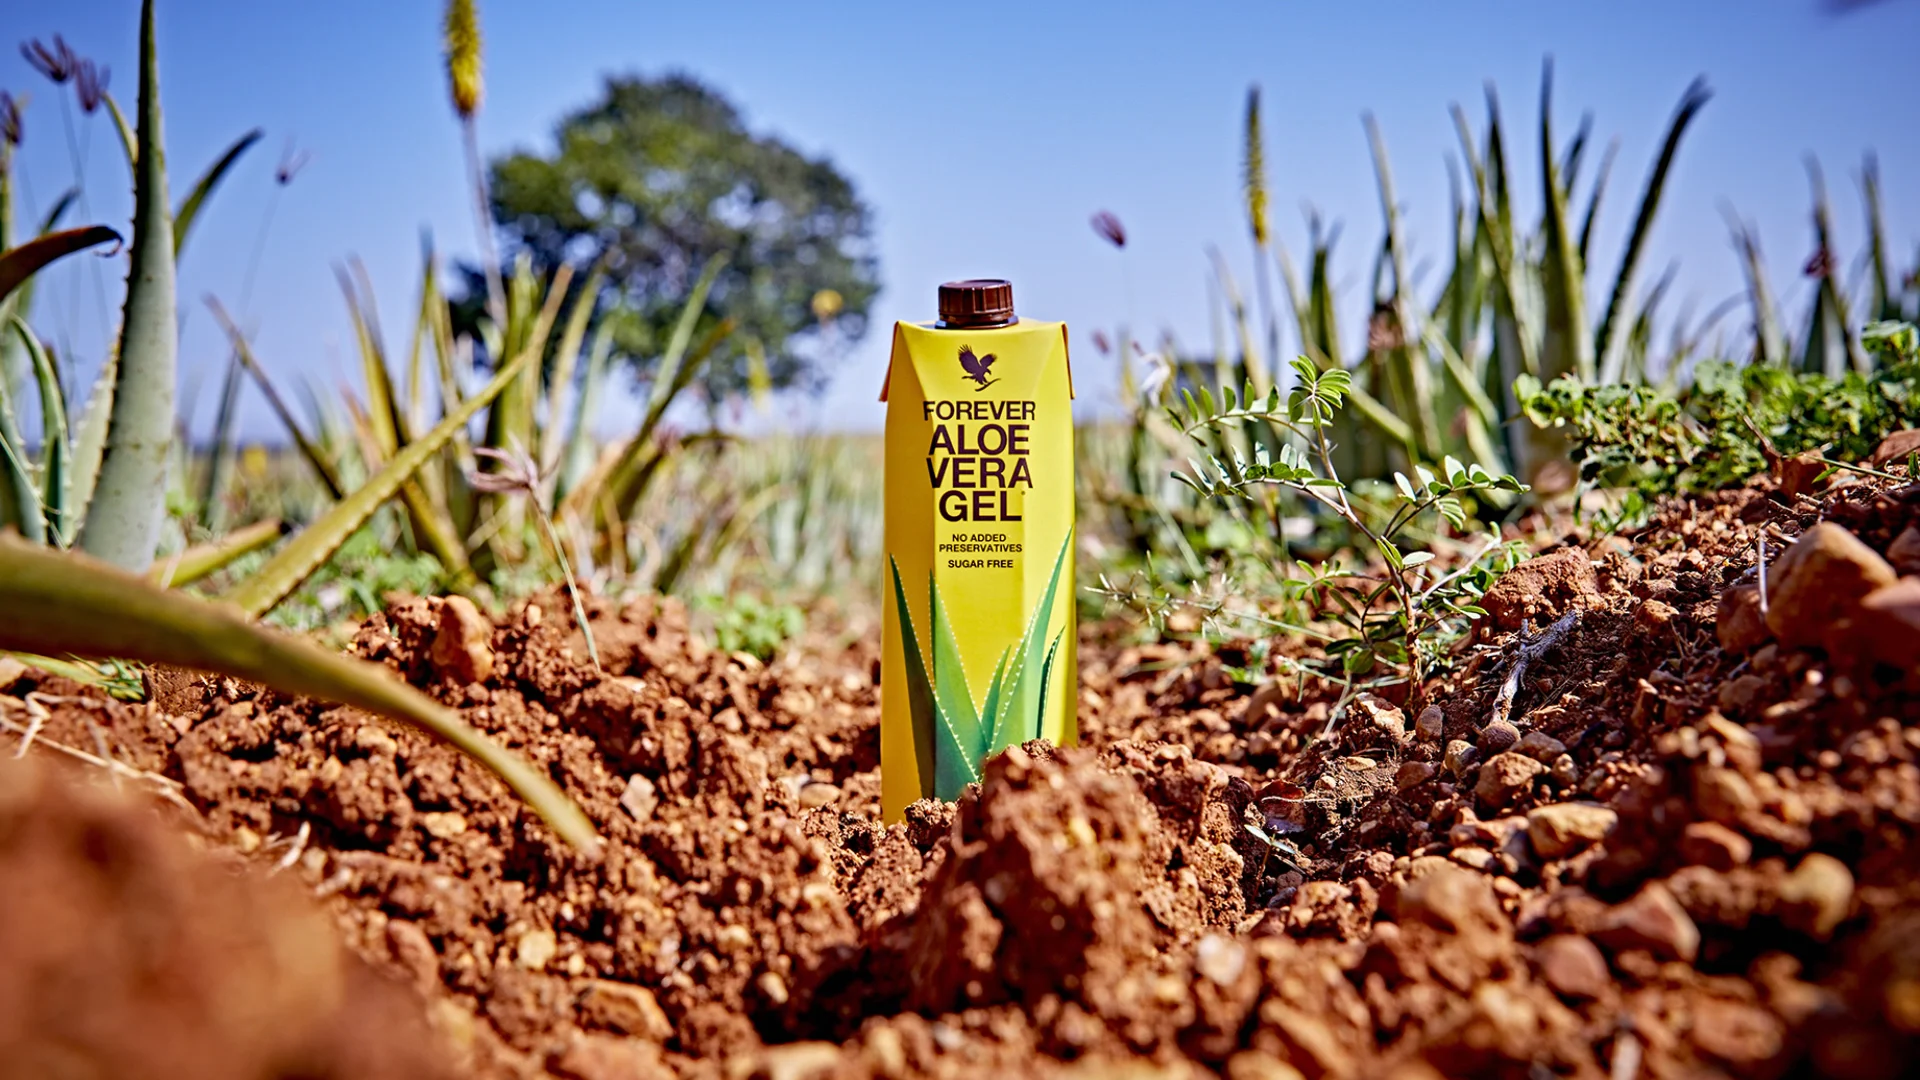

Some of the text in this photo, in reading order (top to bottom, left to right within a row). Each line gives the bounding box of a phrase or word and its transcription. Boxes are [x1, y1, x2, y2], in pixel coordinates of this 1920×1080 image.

[923, 400, 1036, 421] FOREVER
[928, 424, 1030, 456] ALOE
[926, 457, 1034, 489] VERA
[938, 490, 1022, 522] GEL
[939, 544, 1023, 552] PRESERVATIVES
[952, 534, 1007, 542] NO ADDED
[948, 560, 1014, 568] SUGAR FREE
